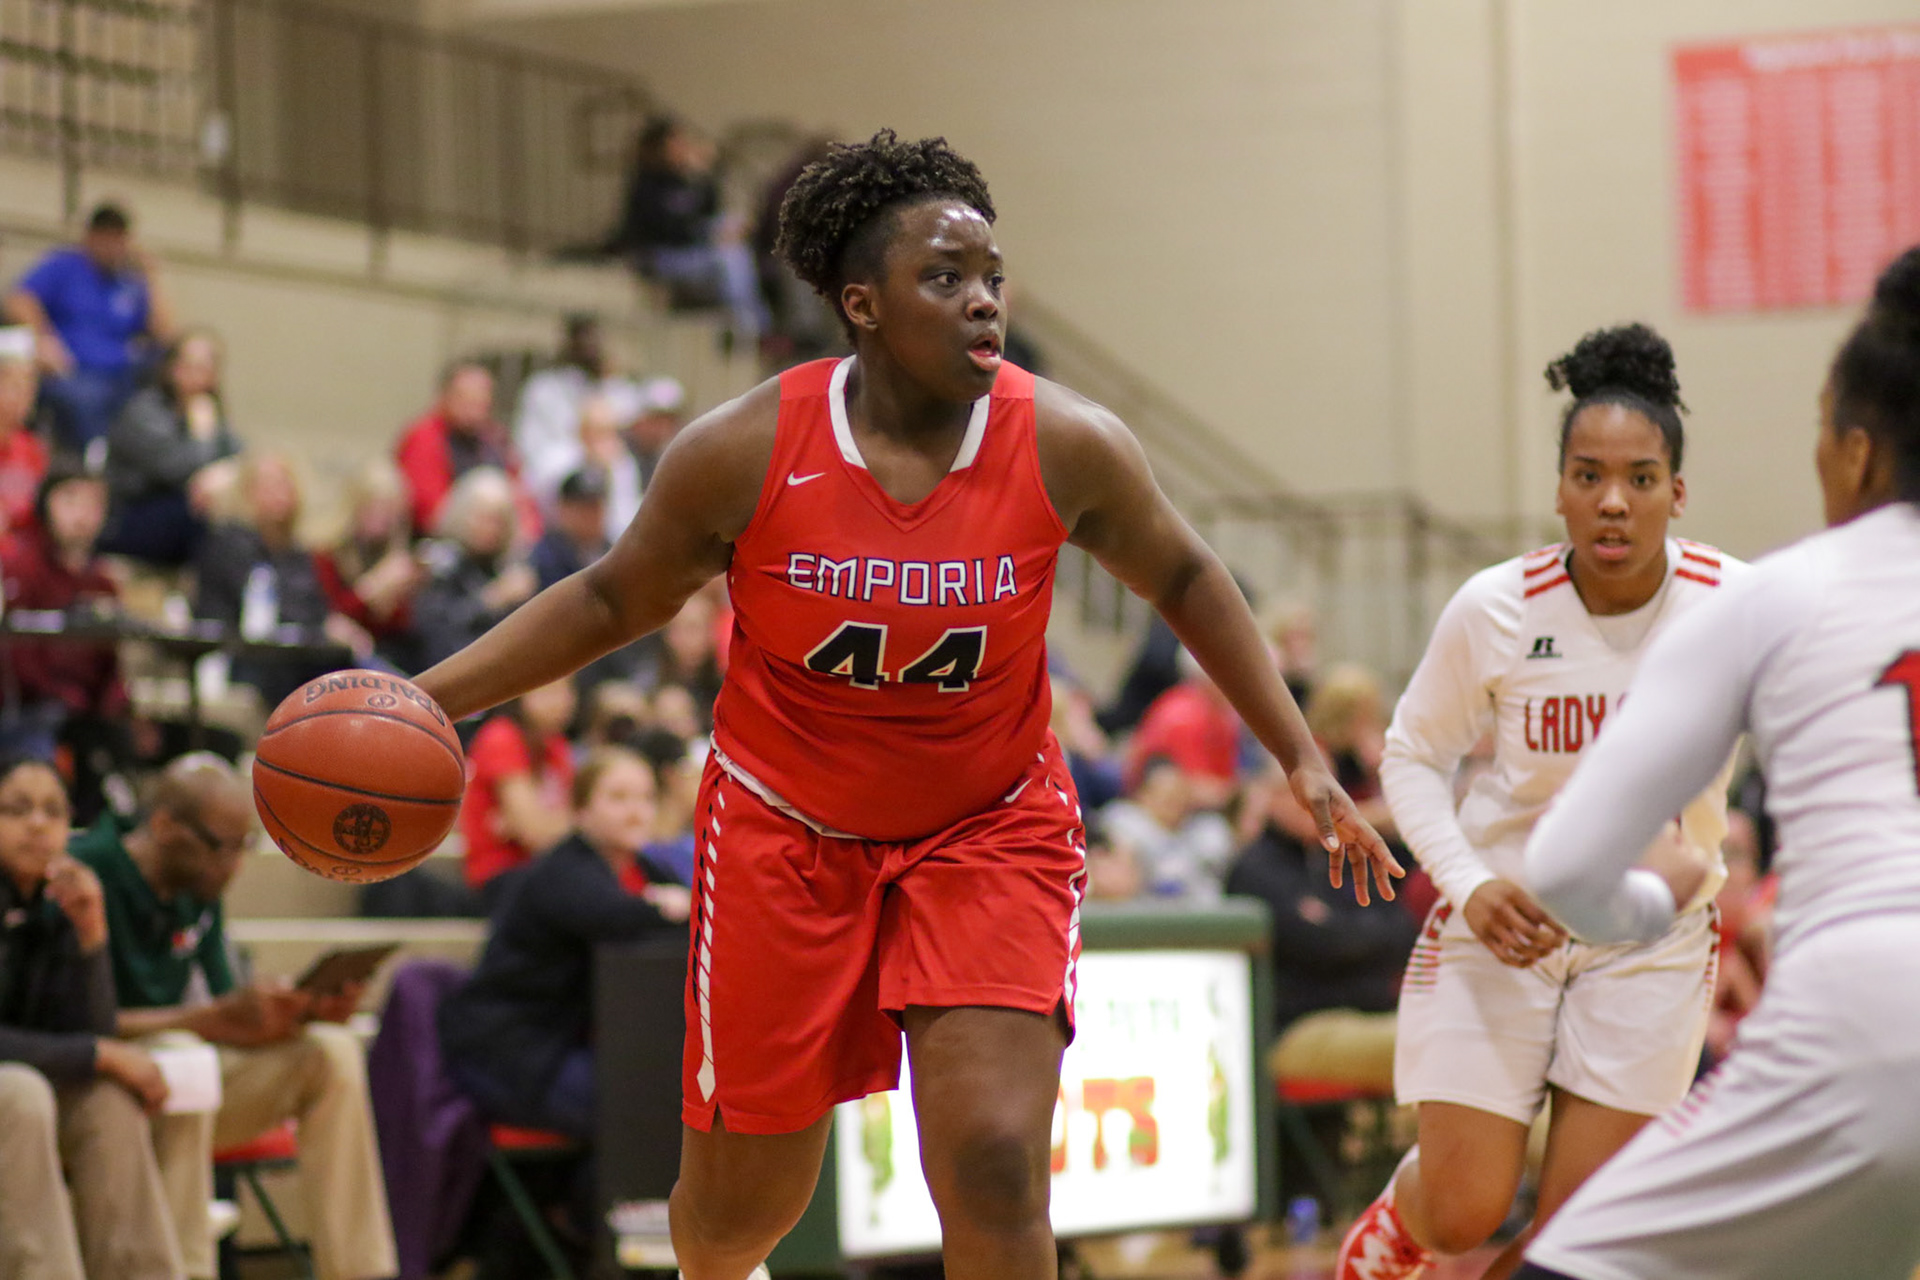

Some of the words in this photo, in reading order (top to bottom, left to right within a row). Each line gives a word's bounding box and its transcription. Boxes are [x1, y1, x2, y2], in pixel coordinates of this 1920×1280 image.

[787, 552, 1019, 607] EMPORIA
[803, 620, 988, 693] 44
[1524, 693, 1606, 753] LADY
